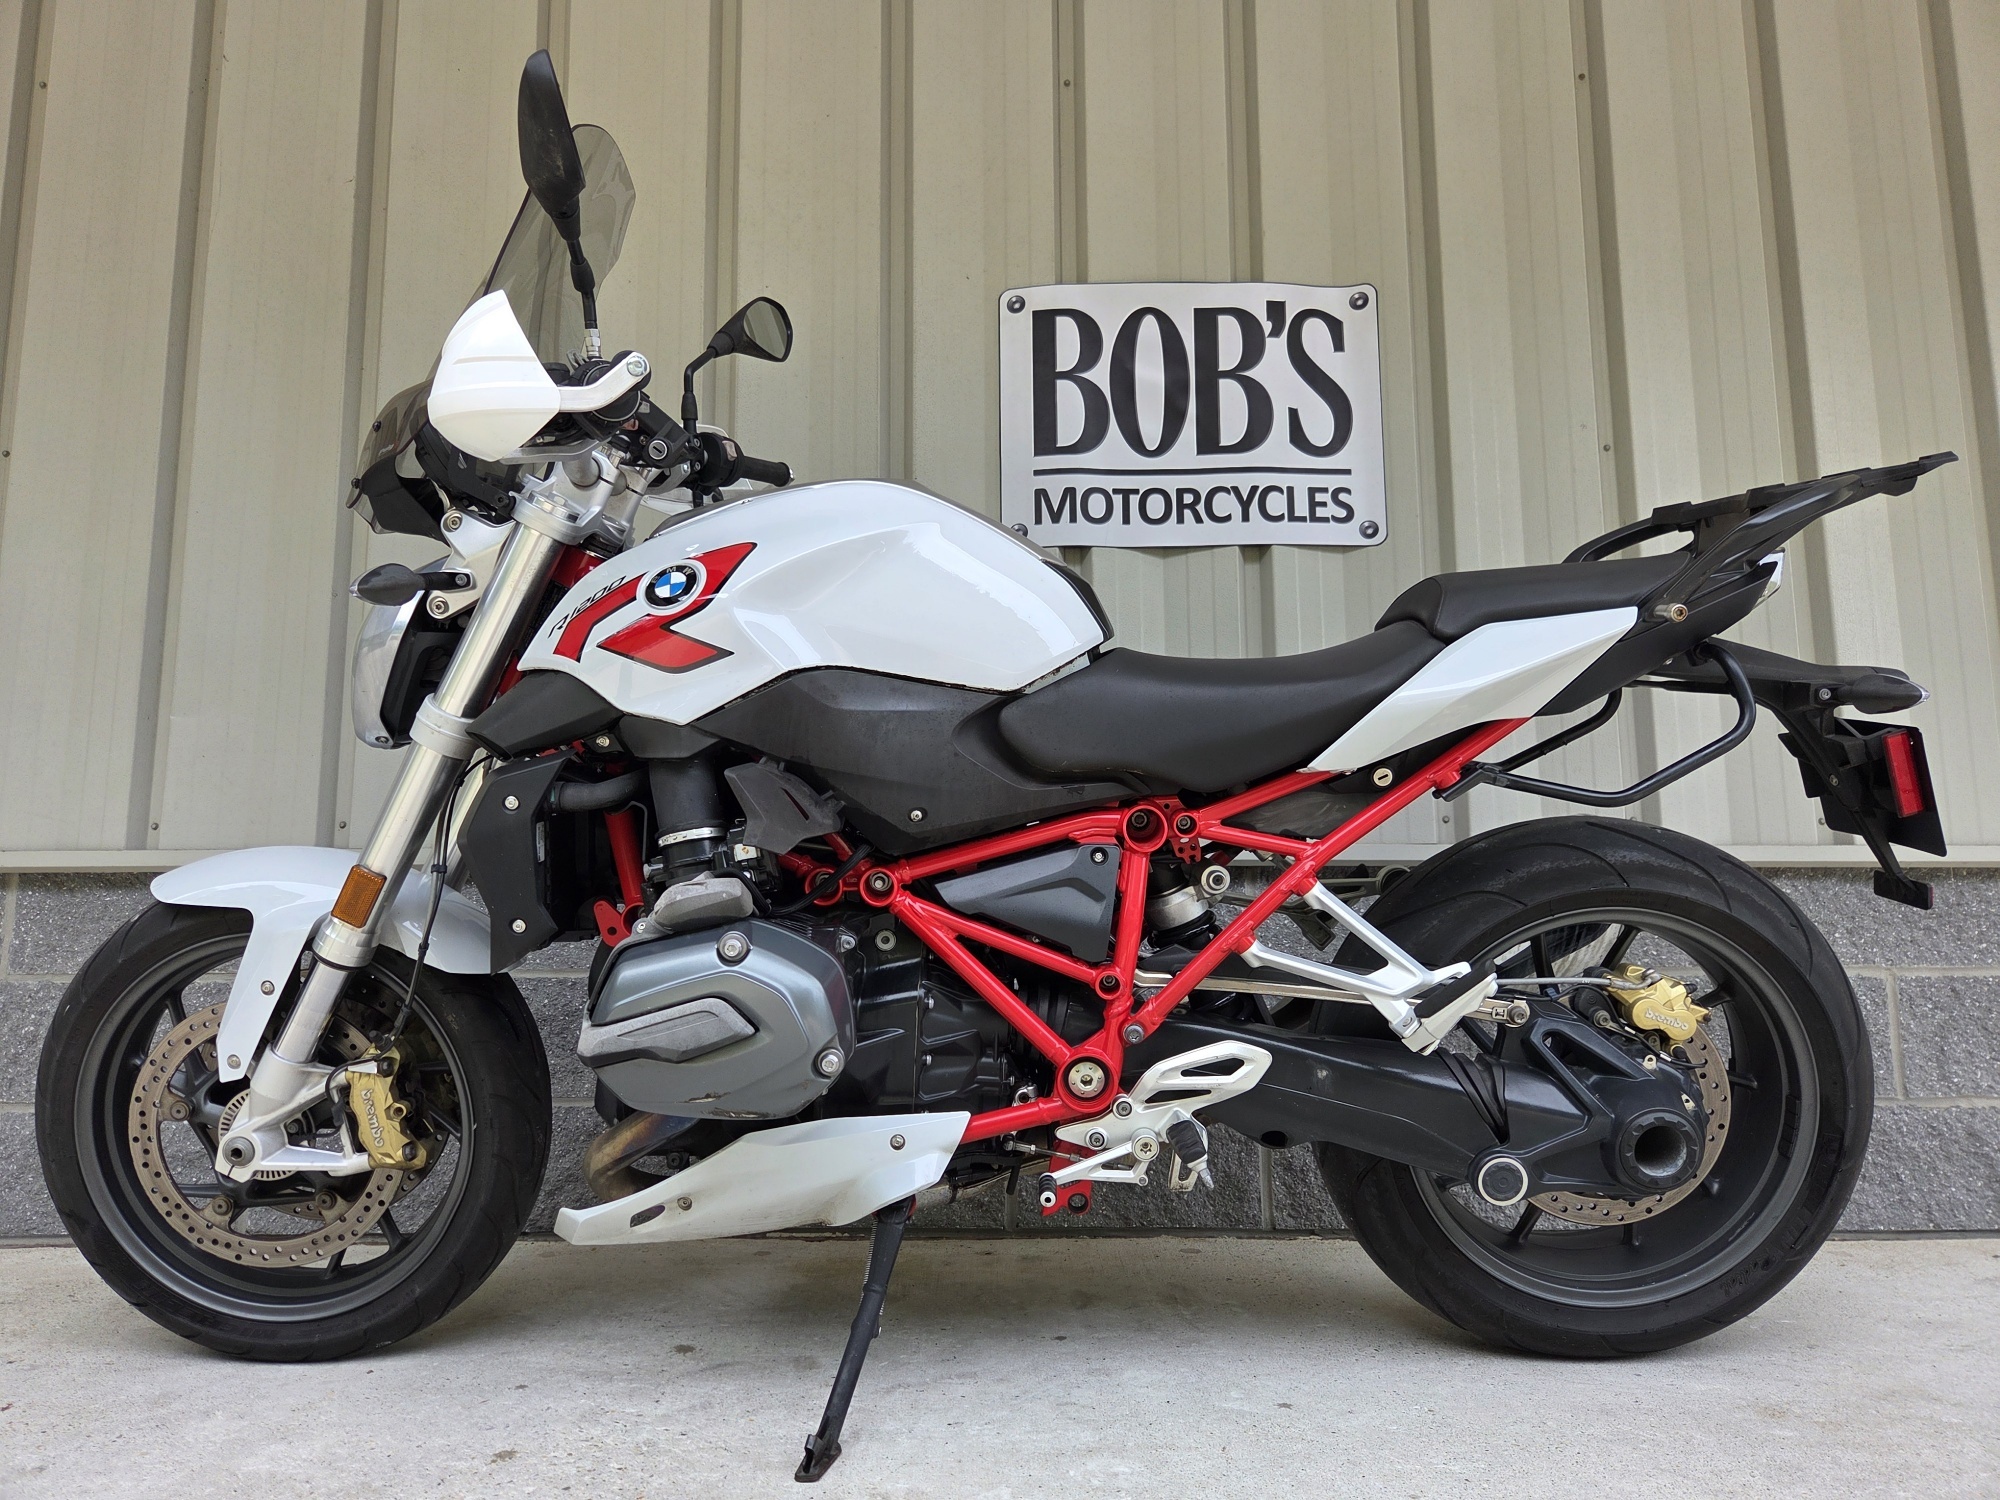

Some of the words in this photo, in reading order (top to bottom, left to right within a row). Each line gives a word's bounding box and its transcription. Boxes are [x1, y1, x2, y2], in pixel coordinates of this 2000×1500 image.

[1032, 300, 1353, 458] BOB'S
[1033, 485, 1355, 525] MOTORCYCLES
[1645, 1007, 1689, 1030] brembo
[360, 1088, 385, 1148] brembo
